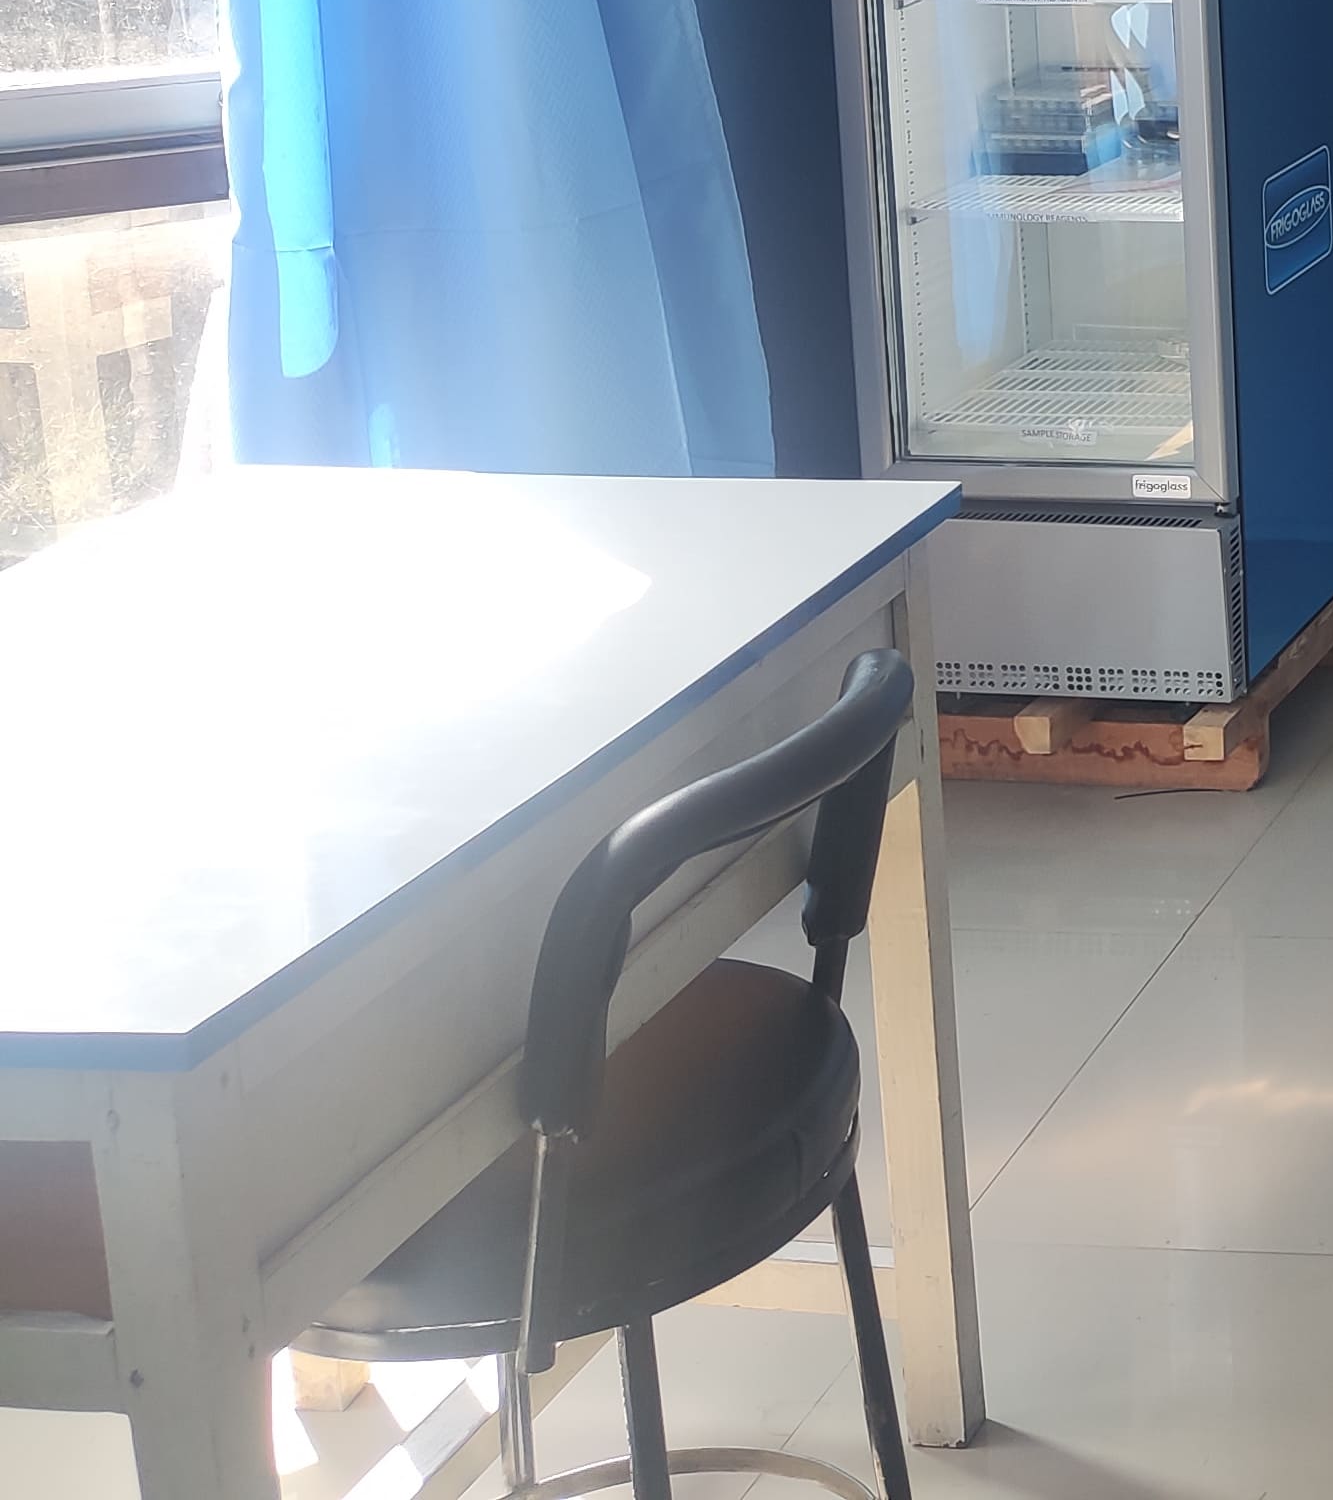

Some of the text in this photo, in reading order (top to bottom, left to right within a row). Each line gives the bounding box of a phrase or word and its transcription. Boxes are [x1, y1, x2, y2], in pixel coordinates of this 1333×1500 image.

[1270, 191, 1325, 243] FRIGOGLASS
[1021, 429, 1055, 438] SAMPLE
[1135, 479, 1188, 493] frigoglass
